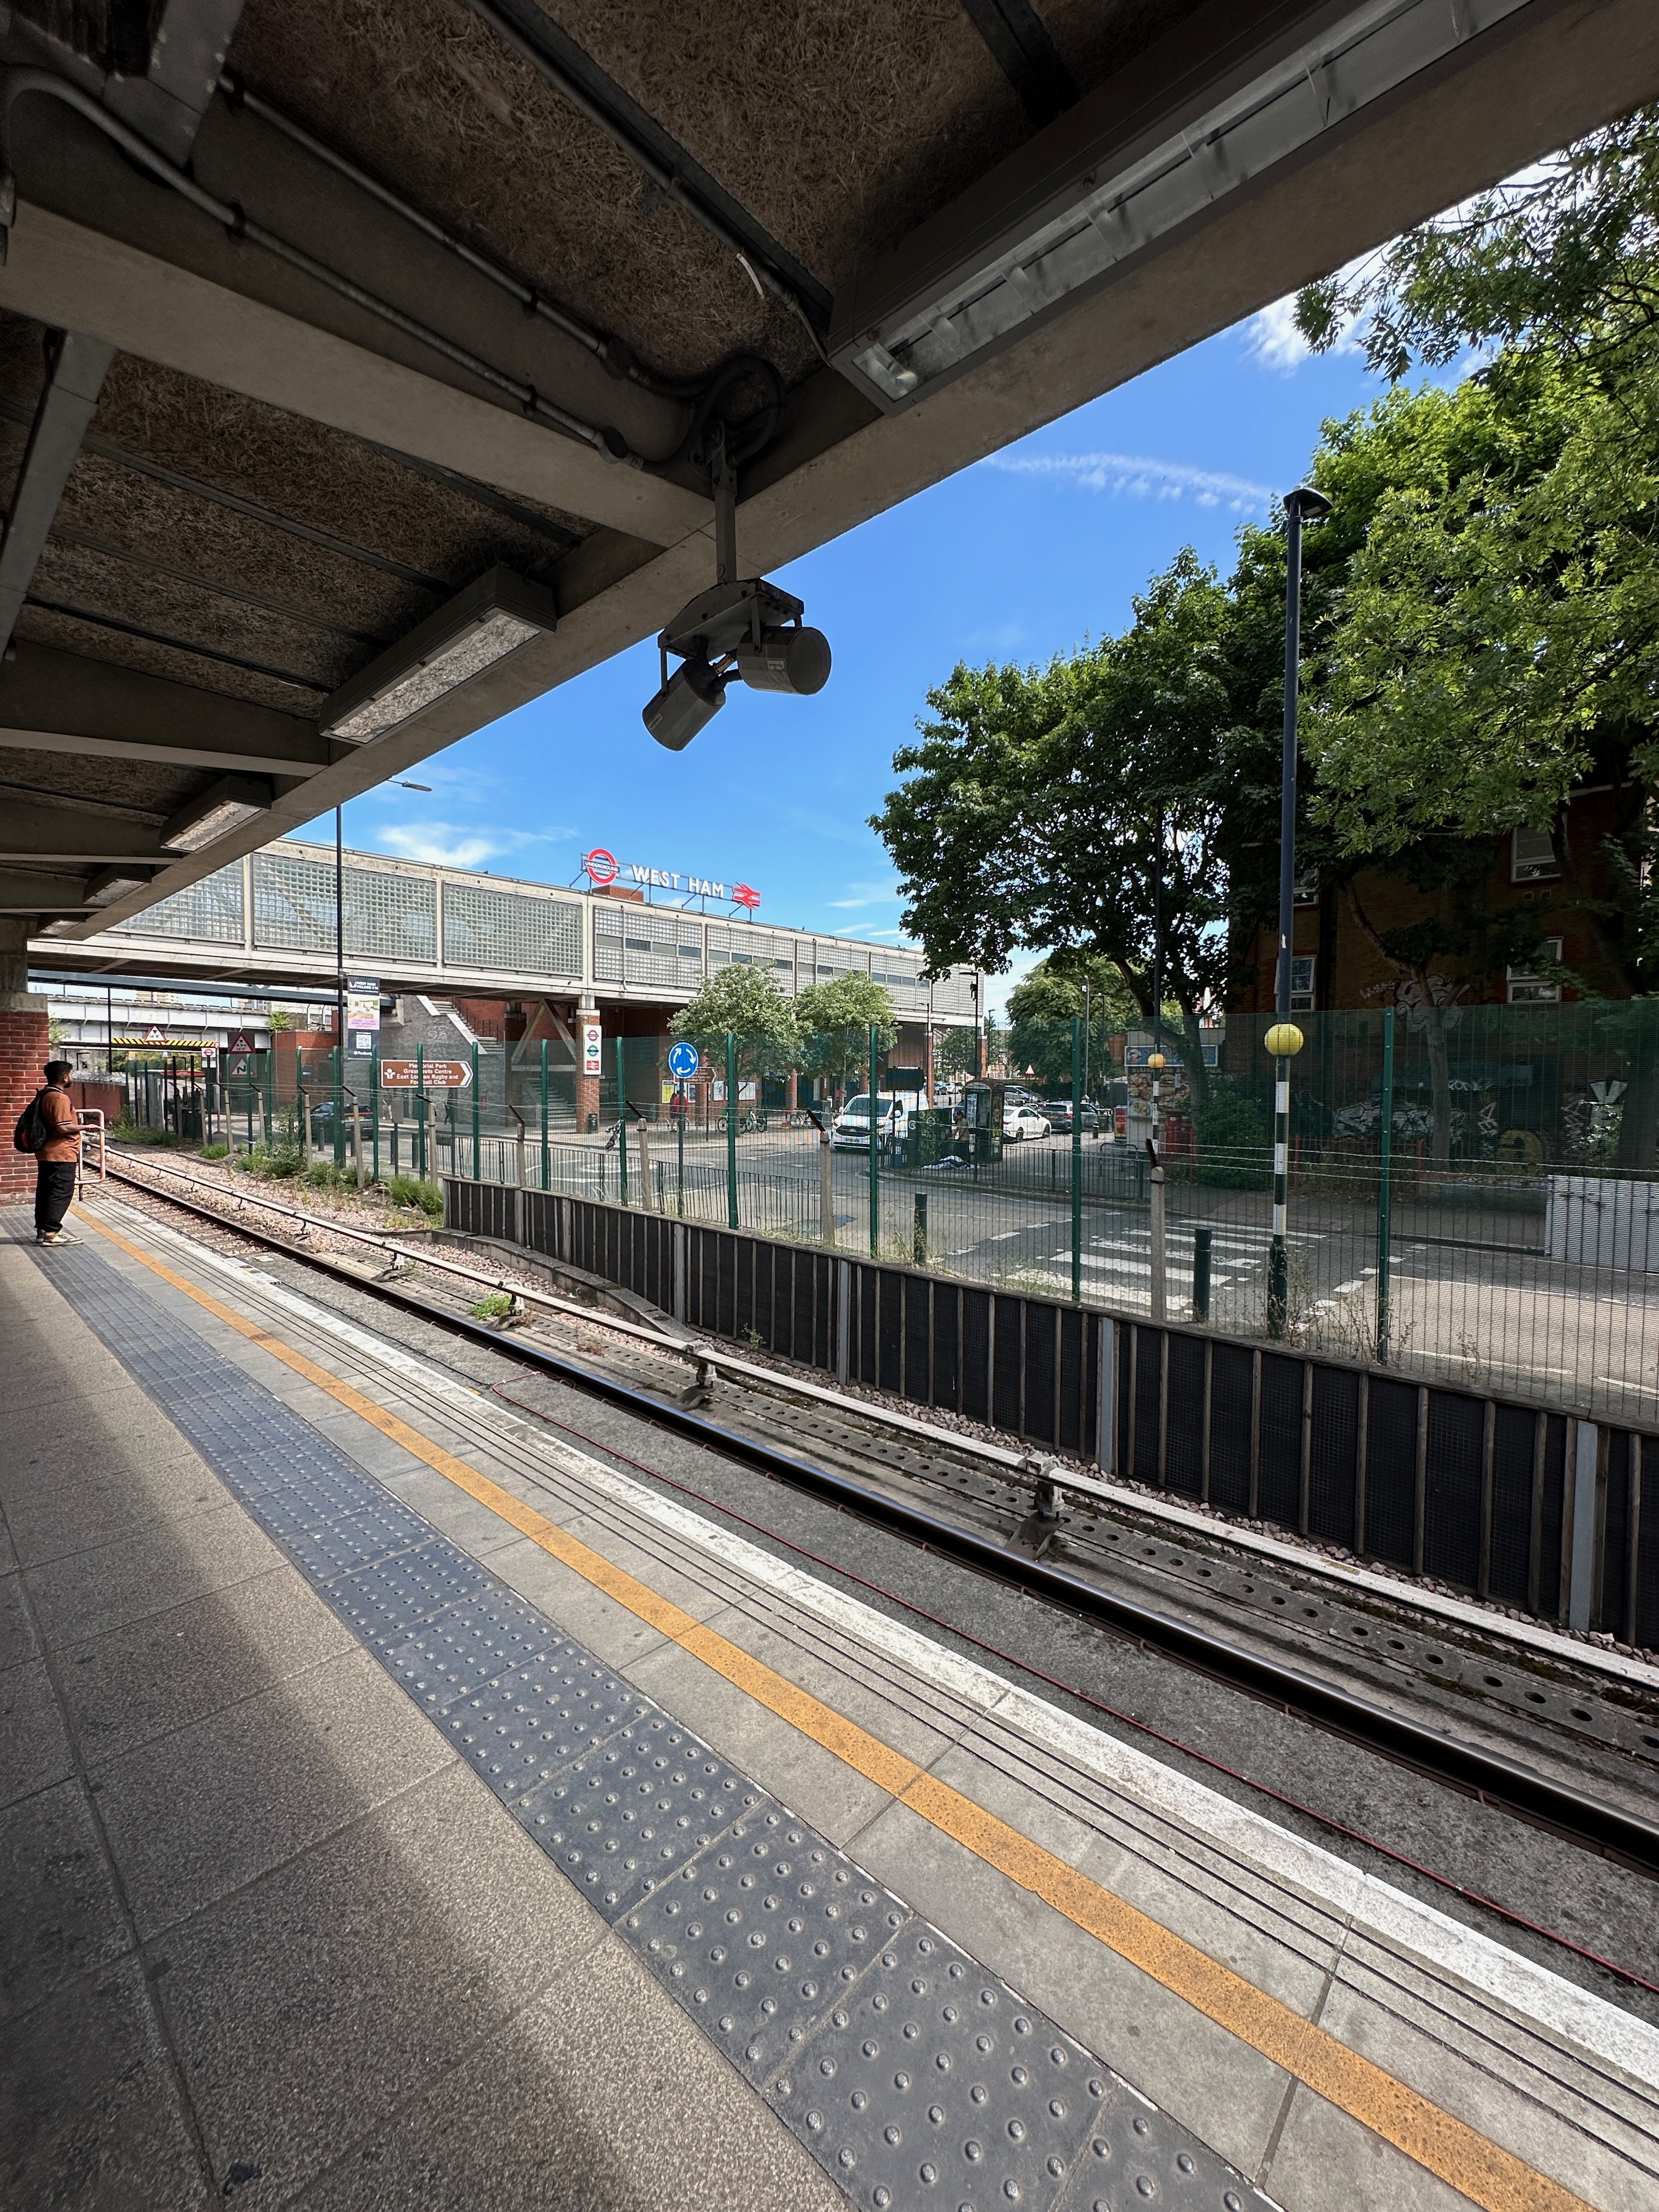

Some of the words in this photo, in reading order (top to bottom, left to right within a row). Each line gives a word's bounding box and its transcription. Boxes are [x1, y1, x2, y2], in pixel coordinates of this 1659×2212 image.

[585, 861, 619, 872] UNDERGROUND
[632, 865, 680, 889] WEST
[689, 877, 724, 899] HAM
